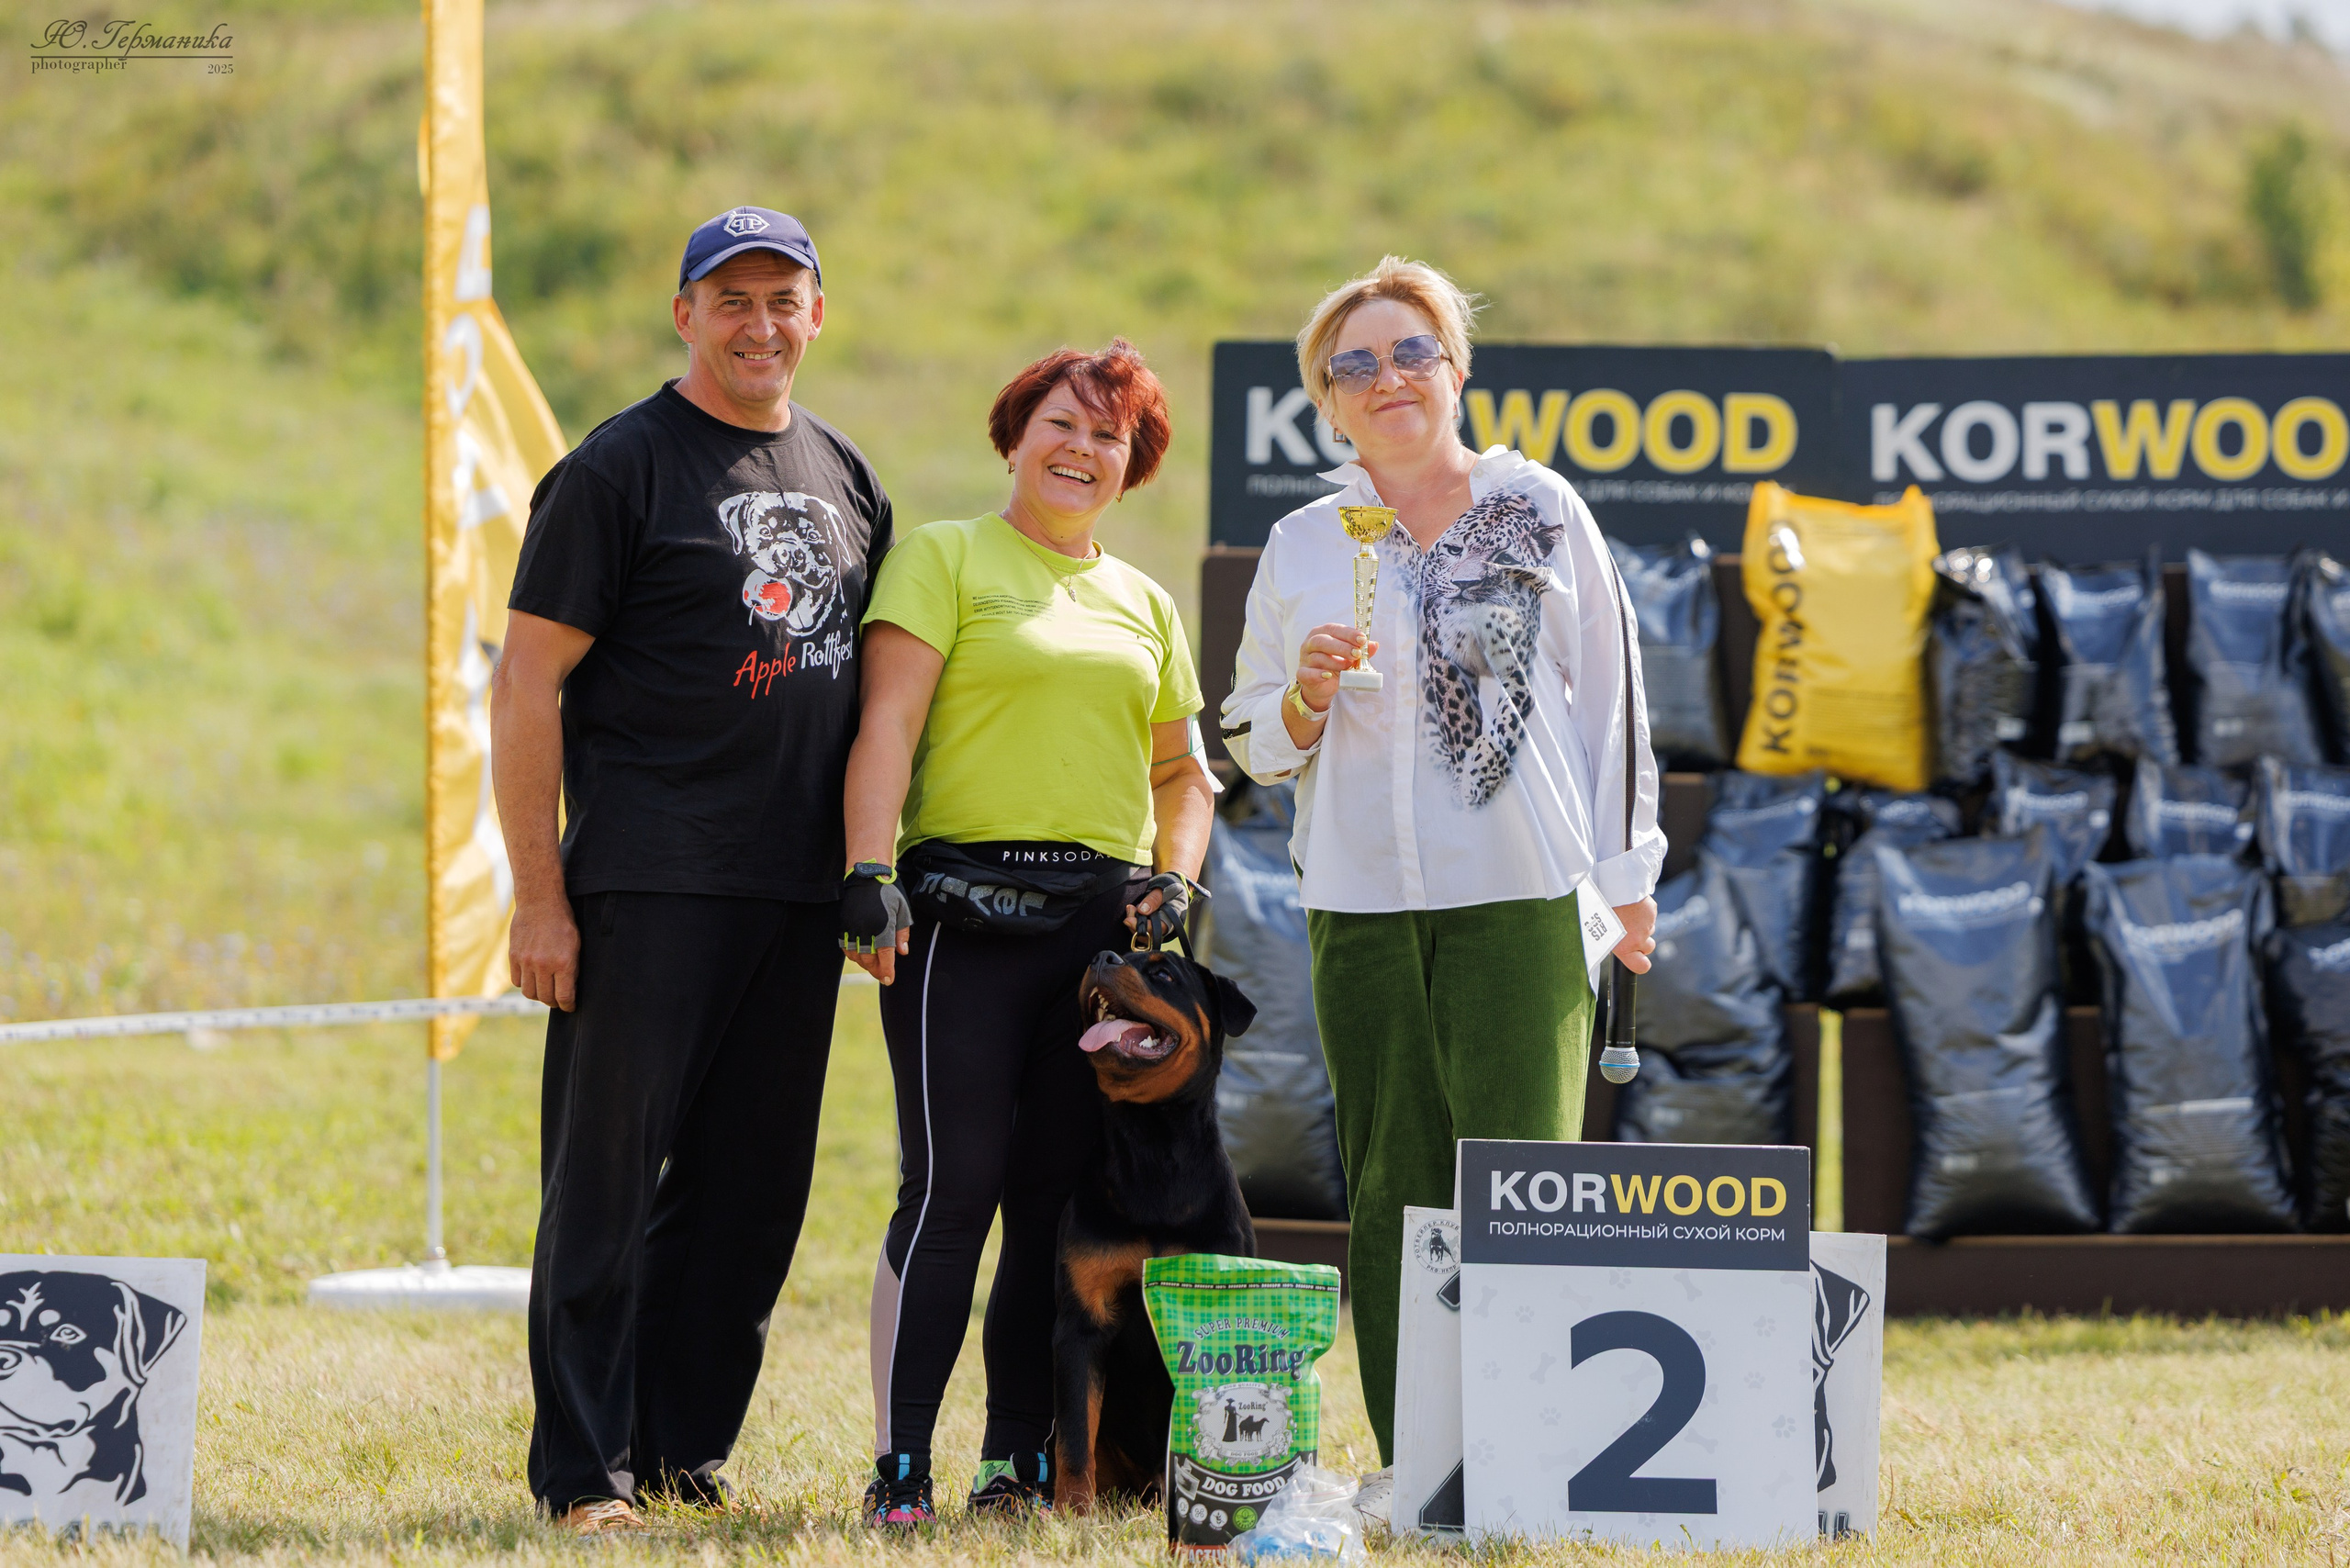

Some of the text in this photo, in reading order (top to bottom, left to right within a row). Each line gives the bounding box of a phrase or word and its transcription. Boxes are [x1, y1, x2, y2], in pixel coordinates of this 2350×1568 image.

[1246, 386, 1798, 474] KWOOD
[733, 643, 796, 700] Apple
[1003, 850, 1104, 862] PINKSODA
[1491, 1170, 1787, 1216] KORWOOD
[1489, 1221, 1785, 1242] ПОЛНОРАЦИОННЫЙ СУХОЙ КОРМ
[1194, 1317, 1290, 1340] SUPER PREMIUM
[1177, 1340, 1305, 1381] ZooRing
[1567, 1310, 1718, 1514] 2
[1202, 1476, 1285, 1496] DOG FOOD
